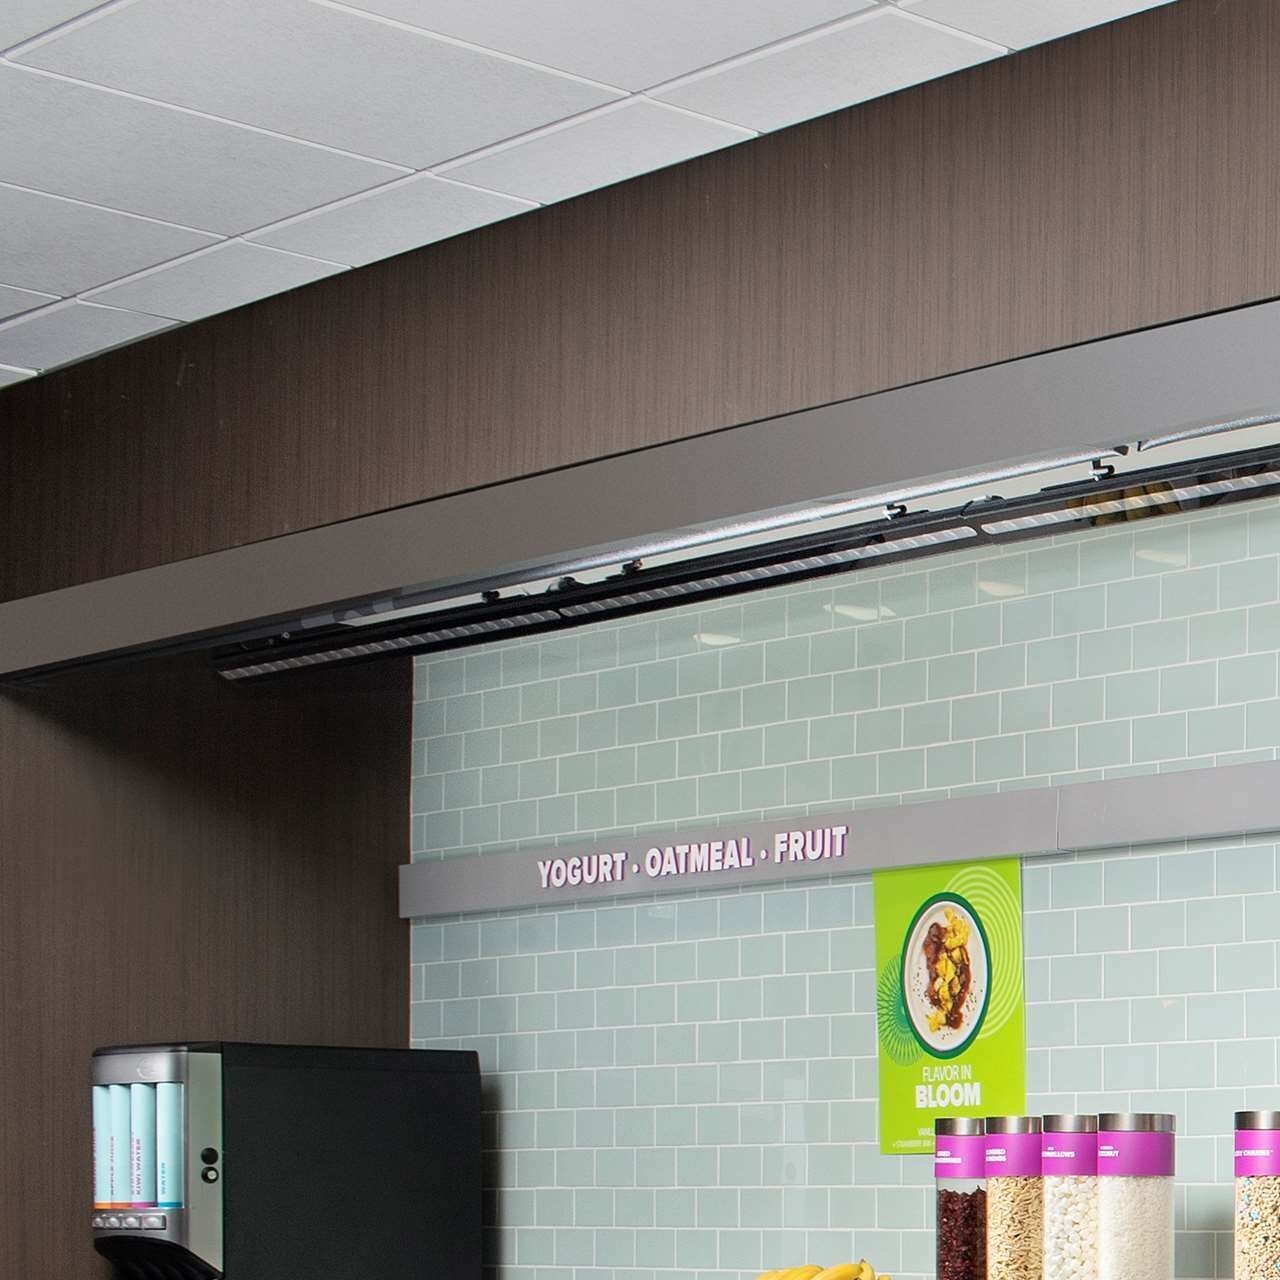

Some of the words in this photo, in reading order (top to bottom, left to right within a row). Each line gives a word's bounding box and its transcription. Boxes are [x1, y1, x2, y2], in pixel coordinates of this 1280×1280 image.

[538, 852, 627, 889] YOGURT
[645, 837, 753, 877] OATMEAL
[774, 826, 848, 863] FRUIT
[922, 1065, 960, 1082] FLAVOR
[961, 1063, 973, 1080] IN
[915, 1082, 981, 1108] BLOOM
